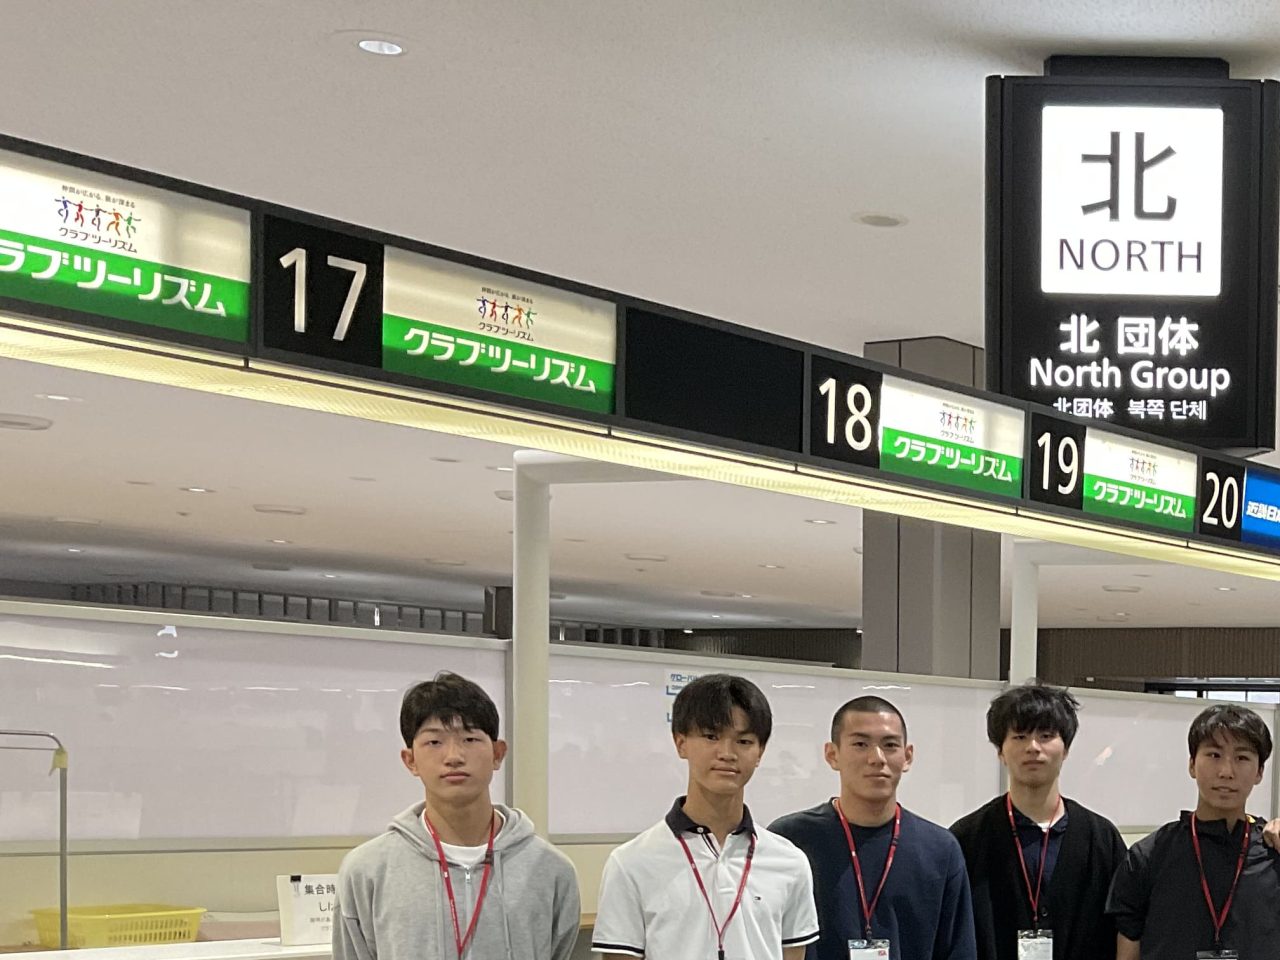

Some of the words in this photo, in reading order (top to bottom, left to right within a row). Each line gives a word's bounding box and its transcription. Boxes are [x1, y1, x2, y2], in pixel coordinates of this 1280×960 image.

[1080, 131, 1178, 222] 北
[59, 227, 138, 254] クラブツーリズム
[1058, 238, 1202, 273] NORTH
[0, 238, 227, 317] ラブツーリズム
[278, 247, 367, 342] 17
[403, 326, 597, 394] クラブツーリズム
[1058, 313, 1100, 355] 北
[1117, 315, 1200, 356] 団体
[1029, 357, 1122, 389] North
[1130, 361, 1231, 397] Group
[818, 378, 874, 452] 18
[1127, 399, 1165, 420] 북쪽
[1170, 400, 1208, 421] 단체
[893, 435, 1013, 483] クラブツーリズム
[1037, 431, 1080, 496] 19
[1093, 480, 1187, 520] クラブツーリズム
[1202, 472, 1239, 530] 20
